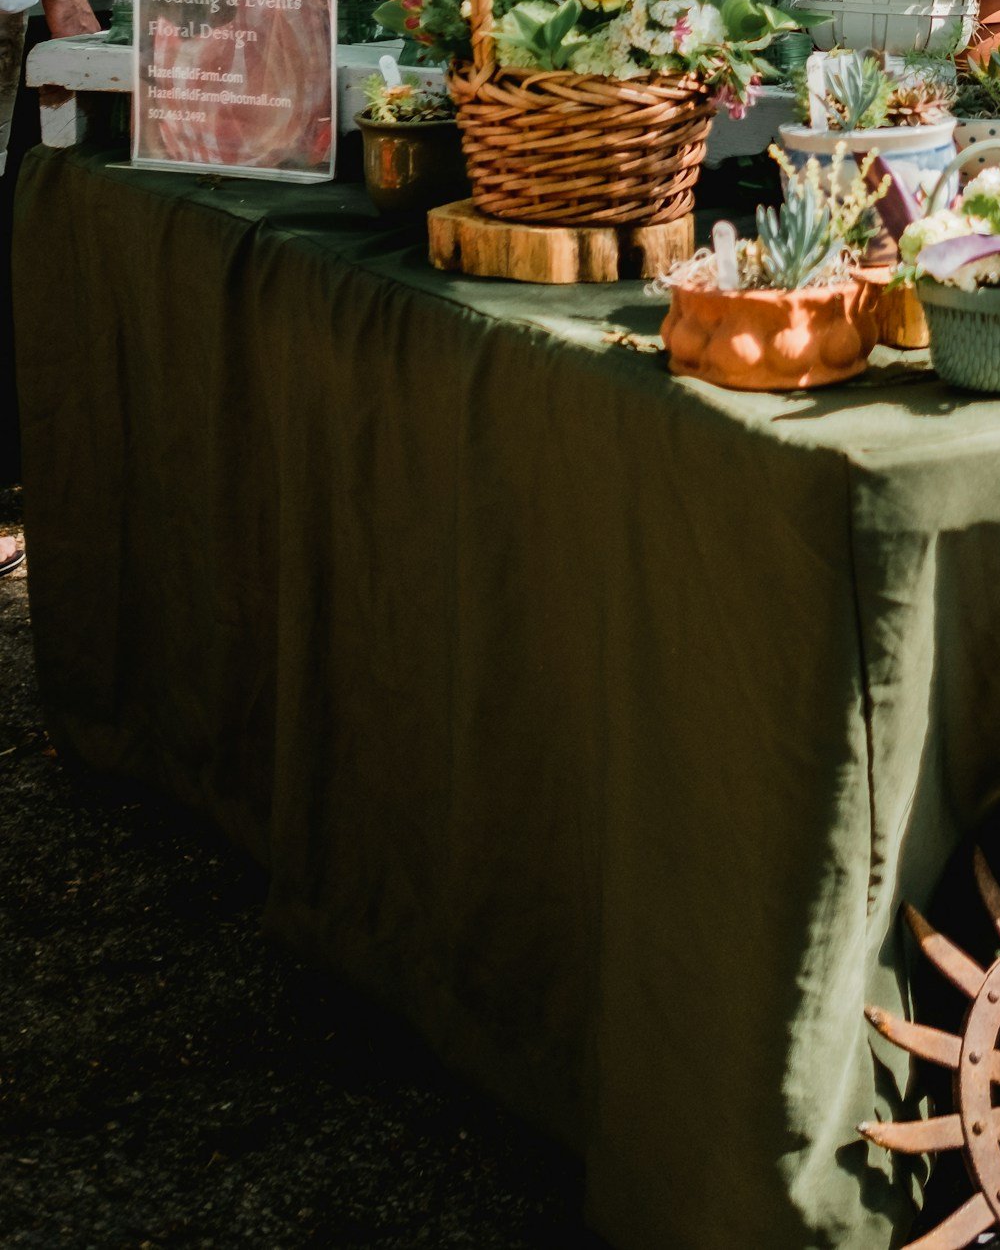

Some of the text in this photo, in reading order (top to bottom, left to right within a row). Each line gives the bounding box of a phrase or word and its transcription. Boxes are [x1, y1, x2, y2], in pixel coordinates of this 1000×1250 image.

[148, 20, 258, 48] Floral Design
[148, 65, 243, 84] HazelfieldFarm.com
[148, 85, 292, 108] HazelfieldFarm@hotmail.com
